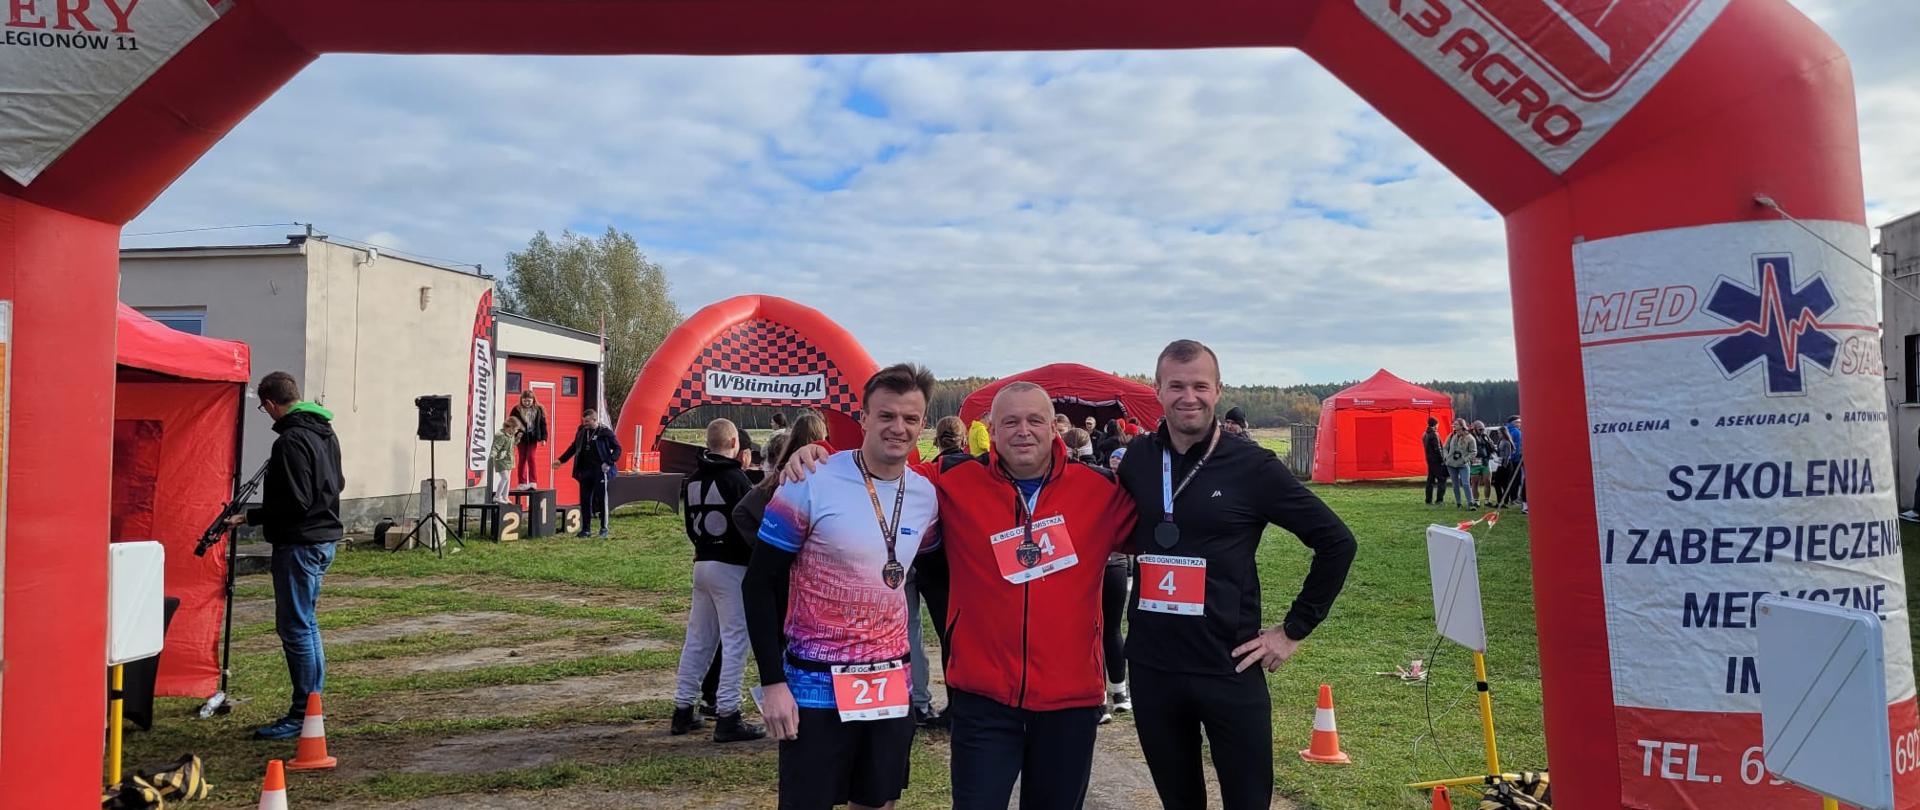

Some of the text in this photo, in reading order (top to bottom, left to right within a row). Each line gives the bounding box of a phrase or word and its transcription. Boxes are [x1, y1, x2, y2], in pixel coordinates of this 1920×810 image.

[116, 37, 139, 50] 11
[1388, 0, 1582, 146] 3 AGRO
[1582, 285, 1697, 334] MED
[709, 373, 822, 397] WBtiming.pl
[1593, 419, 1670, 434] SZKOLENIA
[1715, 413, 1810, 428] ASEKURACJA
[1667, 458, 1875, 501] SZKOLENIA
[540, 498, 547, 524] 1
[566, 509, 581, 533] 3
[501, 511, 520, 541] 2
[1605, 529, 1614, 564] I
[1158, 571, 1177, 596] 4
[1682, 585, 1886, 628] MEZNE
[852, 677, 888, 705] 27
[1637, 740, 1722, 783] TEL.
